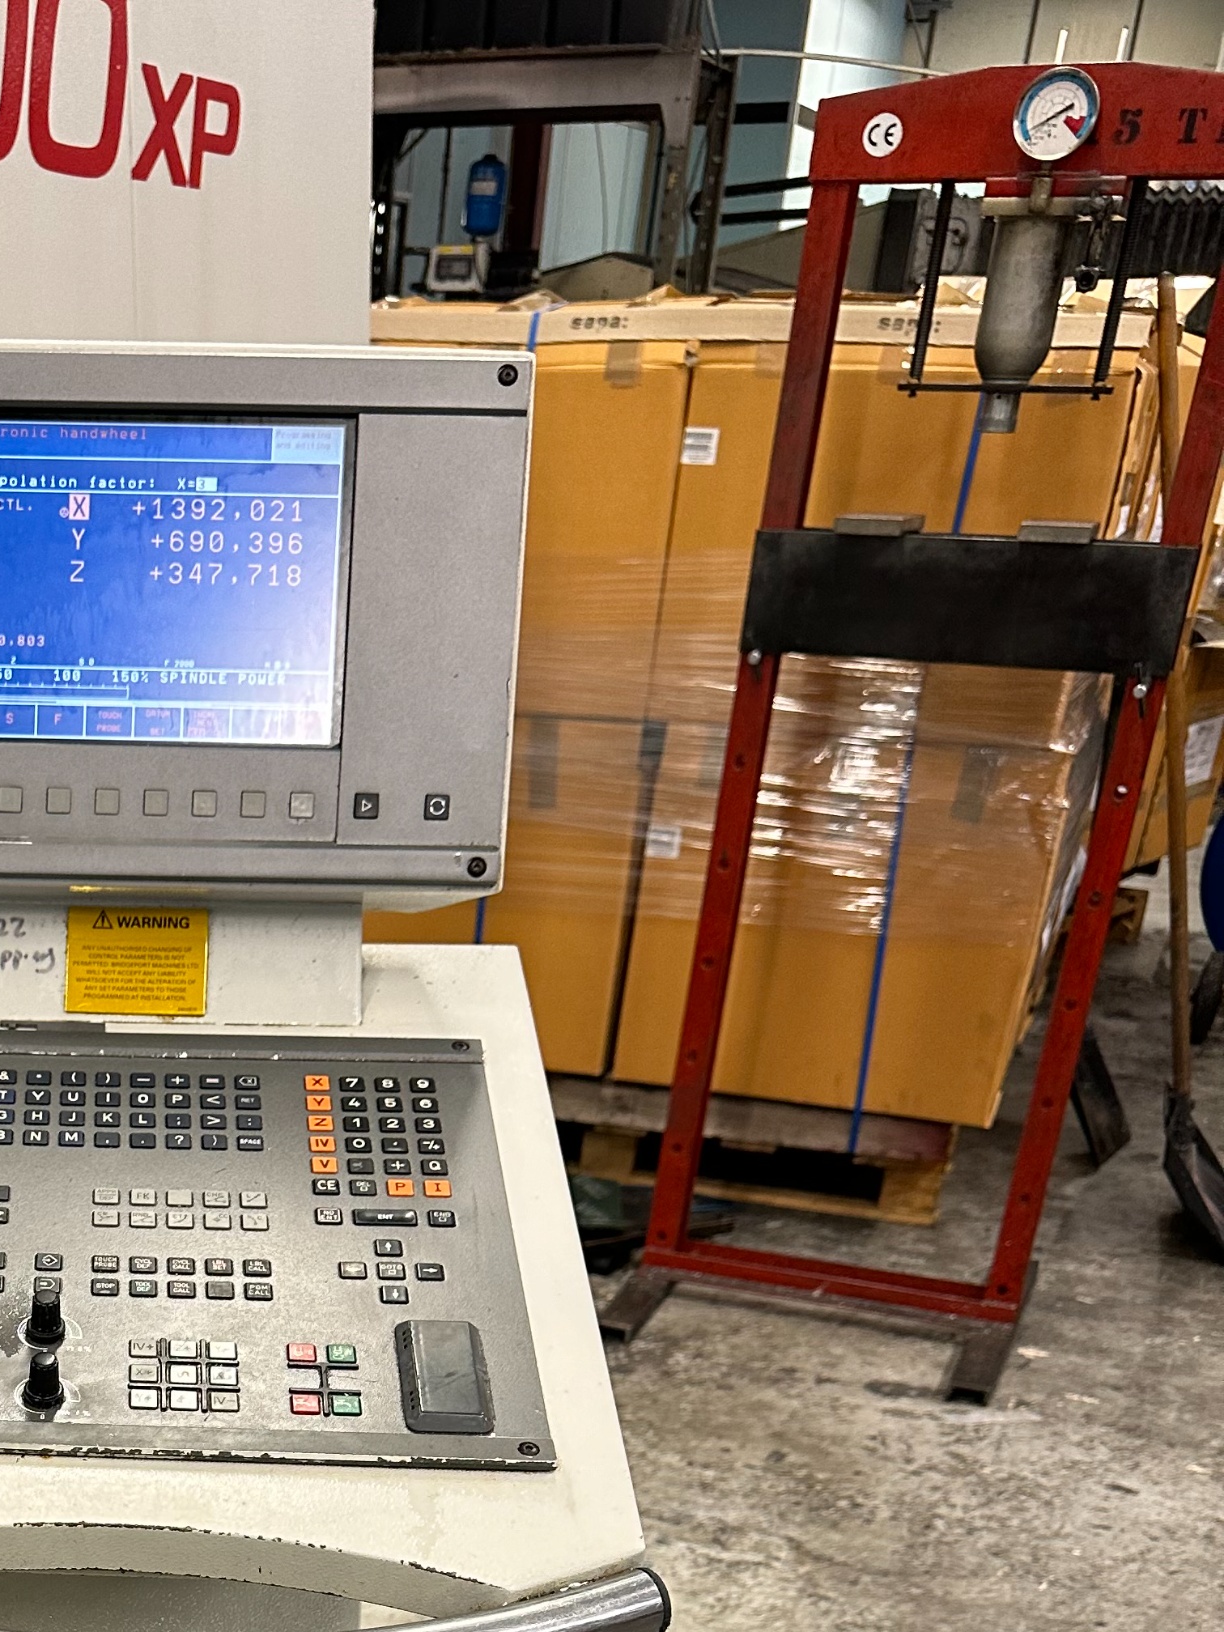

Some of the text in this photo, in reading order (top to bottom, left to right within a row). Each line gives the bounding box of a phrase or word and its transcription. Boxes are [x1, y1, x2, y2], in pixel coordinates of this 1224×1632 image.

[61, 427, 146, 440] handwheel
[89, 476, 155, 489] factor:
[71, 495, 88, 518] X
[131, 497, 303, 522] +1392,021
[72, 528, 303, 554] Y +690,396
[70, 560, 301, 587] Z +347,718
[53, 669, 81, 682] 100
[112, 670, 149, 683] 150%
[160, 672, 227, 685] SPINDLE
[238, 673, 286, 685] POWER
[5, 712, 14, 725] S
[54, 713, 62, 726] F
[117, 917, 190, 929] WARNING
[312, 1078, 323, 1087] X
[346, 1078, 358, 1087] 7
[382, 1079, 394, 1088] 8
[416, 1079, 429, 1089] 9
[0, 1091, 8, 1100] T
[31, 1091, 44, 1101] Y
[68, 1092, 79, 1102] U
[172, 1095, 183, 1104] P
[313, 1098, 324, 1106] Y
[348, 1098, 361, 1107] 4
[384, 1098, 396, 1107] 5
[419, 1099, 432, 1108] 6
[31, 1111, 43, 1121] H
[69, 1112, 76, 1121] J
[102, 1113, 113, 1123] K
[138, 1114, 148, 1124] L
[314, 1118, 328, 1126] Z
[353, 1118, 360, 1128] 1
[386, 1119, 399, 1128] 2
[423, 1120, 435, 1128] 3
[30, 1131, 42, 1141] N
[65, 1132, 78, 1141] M
[315, 1139, 329, 1147] IV
[319, 1159, 330, 1168] V
[429, 1161, 441, 1170] Q
[317, 1180, 336, 1190] CE
[395, 1182, 405, 1191] P
